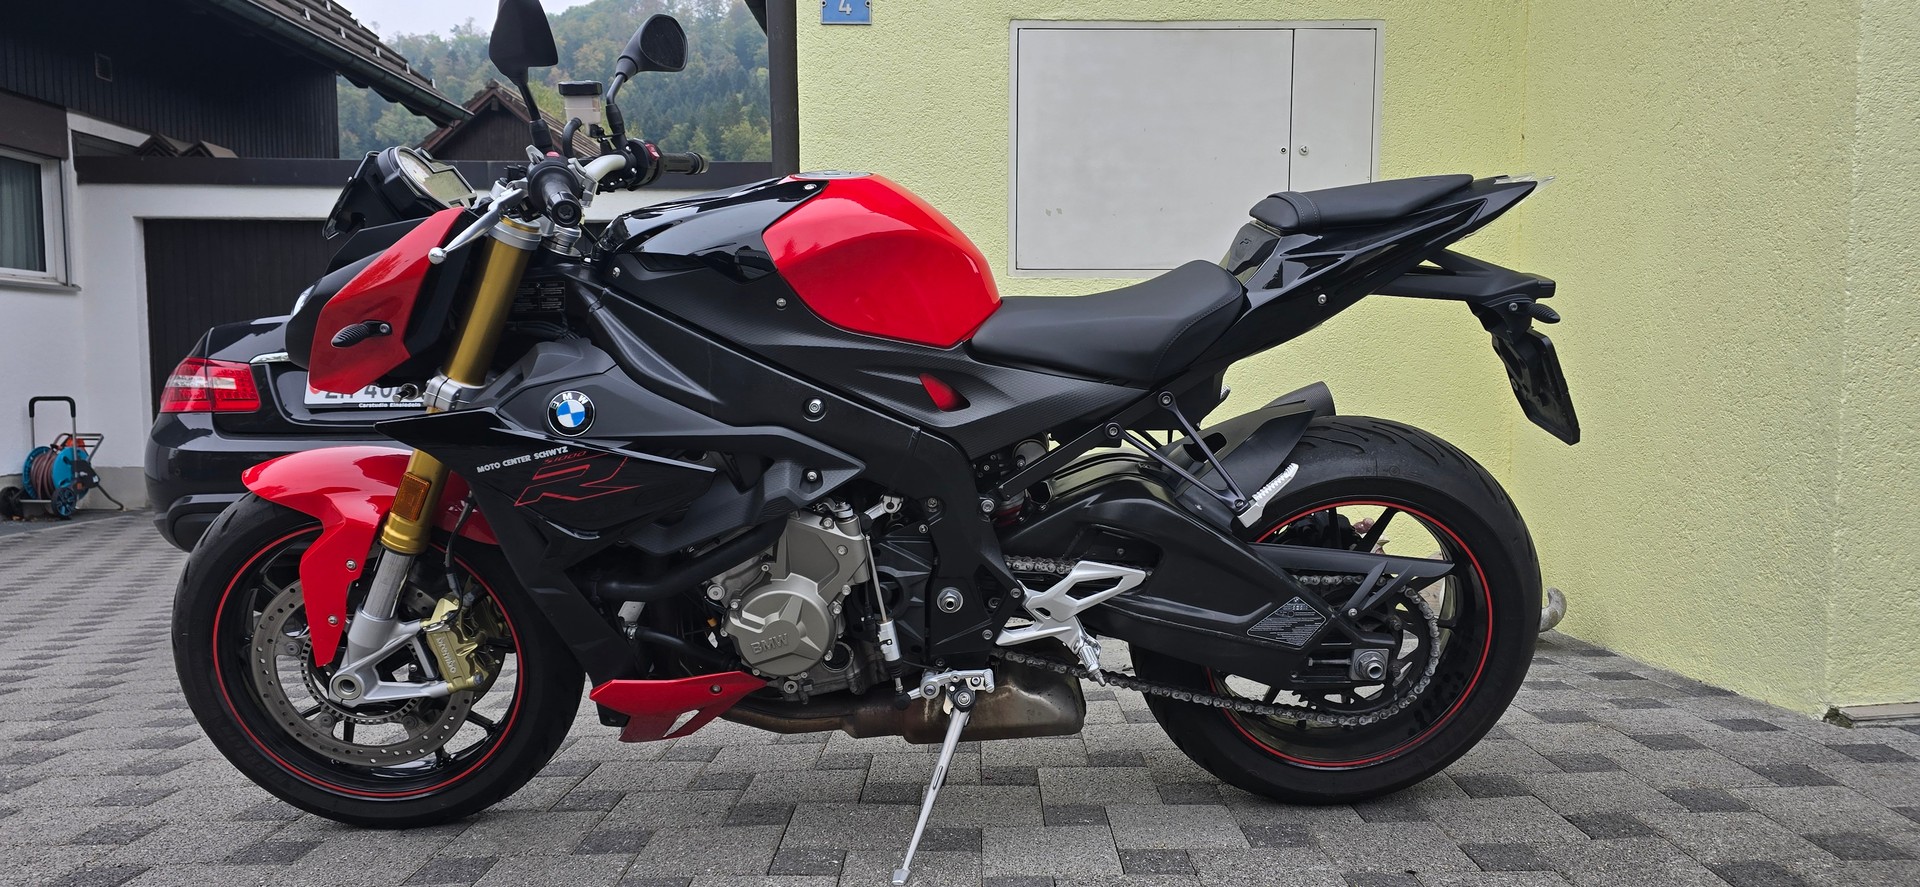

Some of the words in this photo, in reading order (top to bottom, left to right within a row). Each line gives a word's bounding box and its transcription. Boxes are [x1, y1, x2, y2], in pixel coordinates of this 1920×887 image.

[838, 0, 852, 15] 4
[549, 392, 589, 409] BMW
[476, 462, 501, 473] MOTO
[502, 454, 532, 467] CENTER
[533, 446, 568, 460] SCHWYZ
[544, 451, 587, 464] S1000
[750, 633, 789, 655] BMW
[436, 636, 457, 674] brembo
